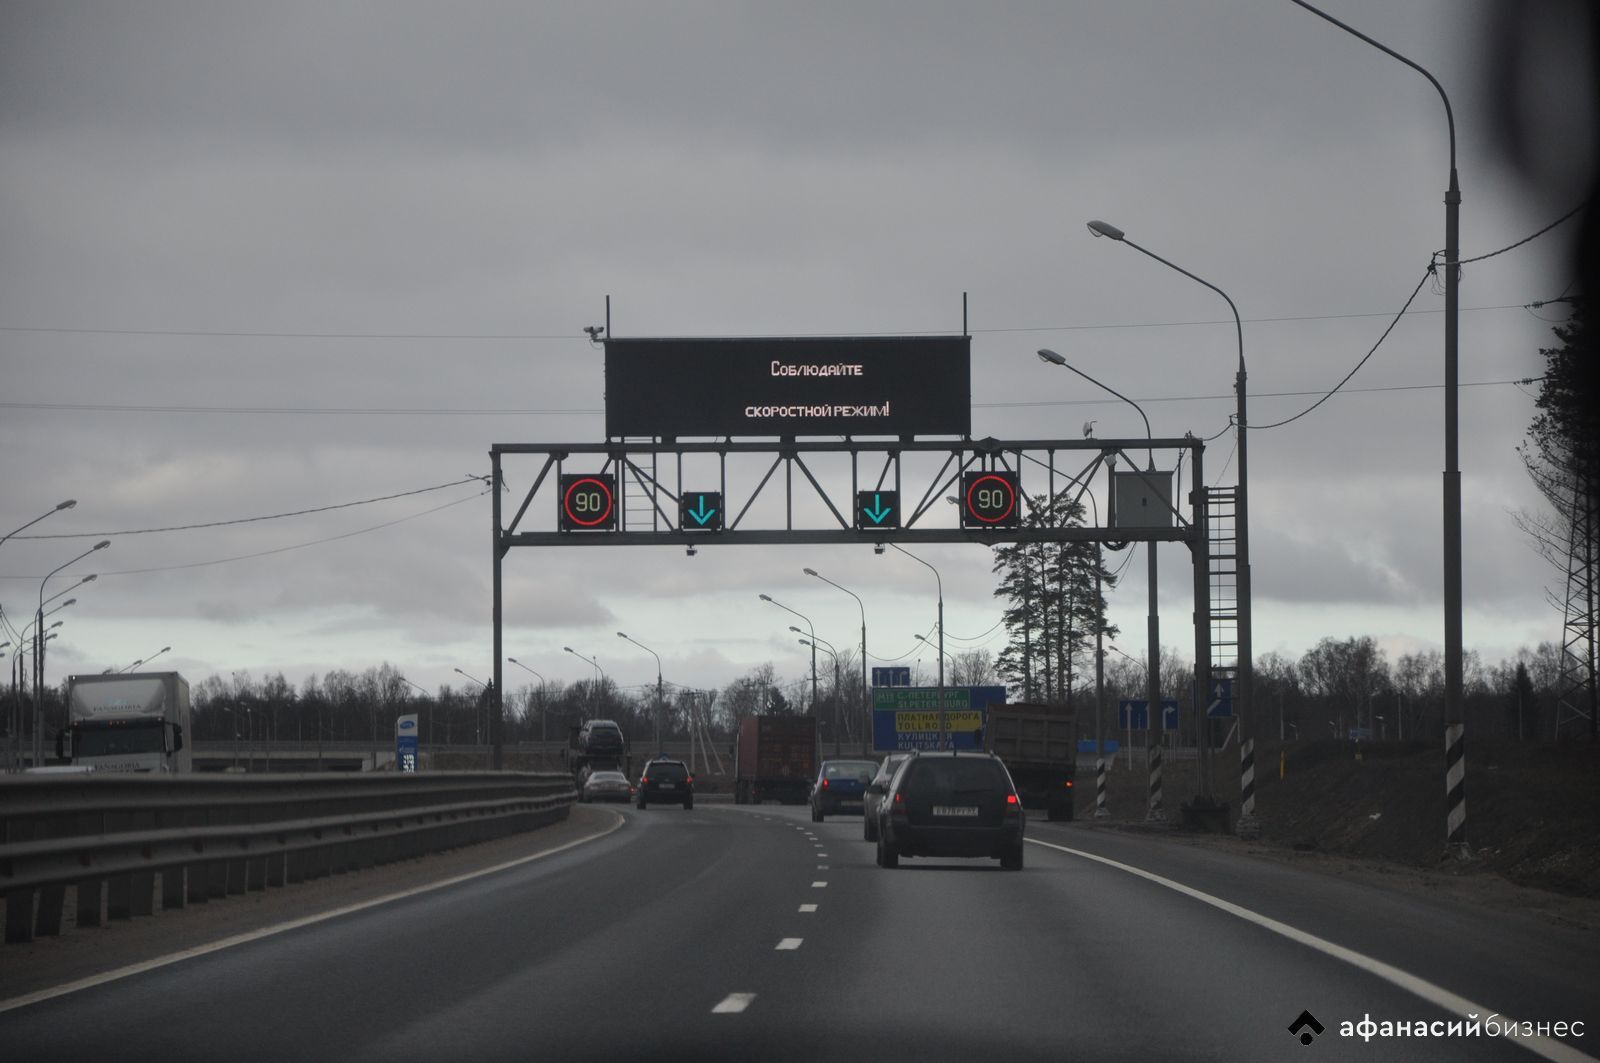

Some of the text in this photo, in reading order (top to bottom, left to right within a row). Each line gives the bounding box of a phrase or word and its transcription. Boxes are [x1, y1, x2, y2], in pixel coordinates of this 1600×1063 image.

[745, 401, 890, 418] СКОРОСТНОЙ РЕЖИМ!
[575, 492, 601, 512] 90
[977, 489, 1004, 509] 90
[898, 722, 952, 730] TOLL ROD
[897, 732, 953, 741] КУЛИЦКЯ
